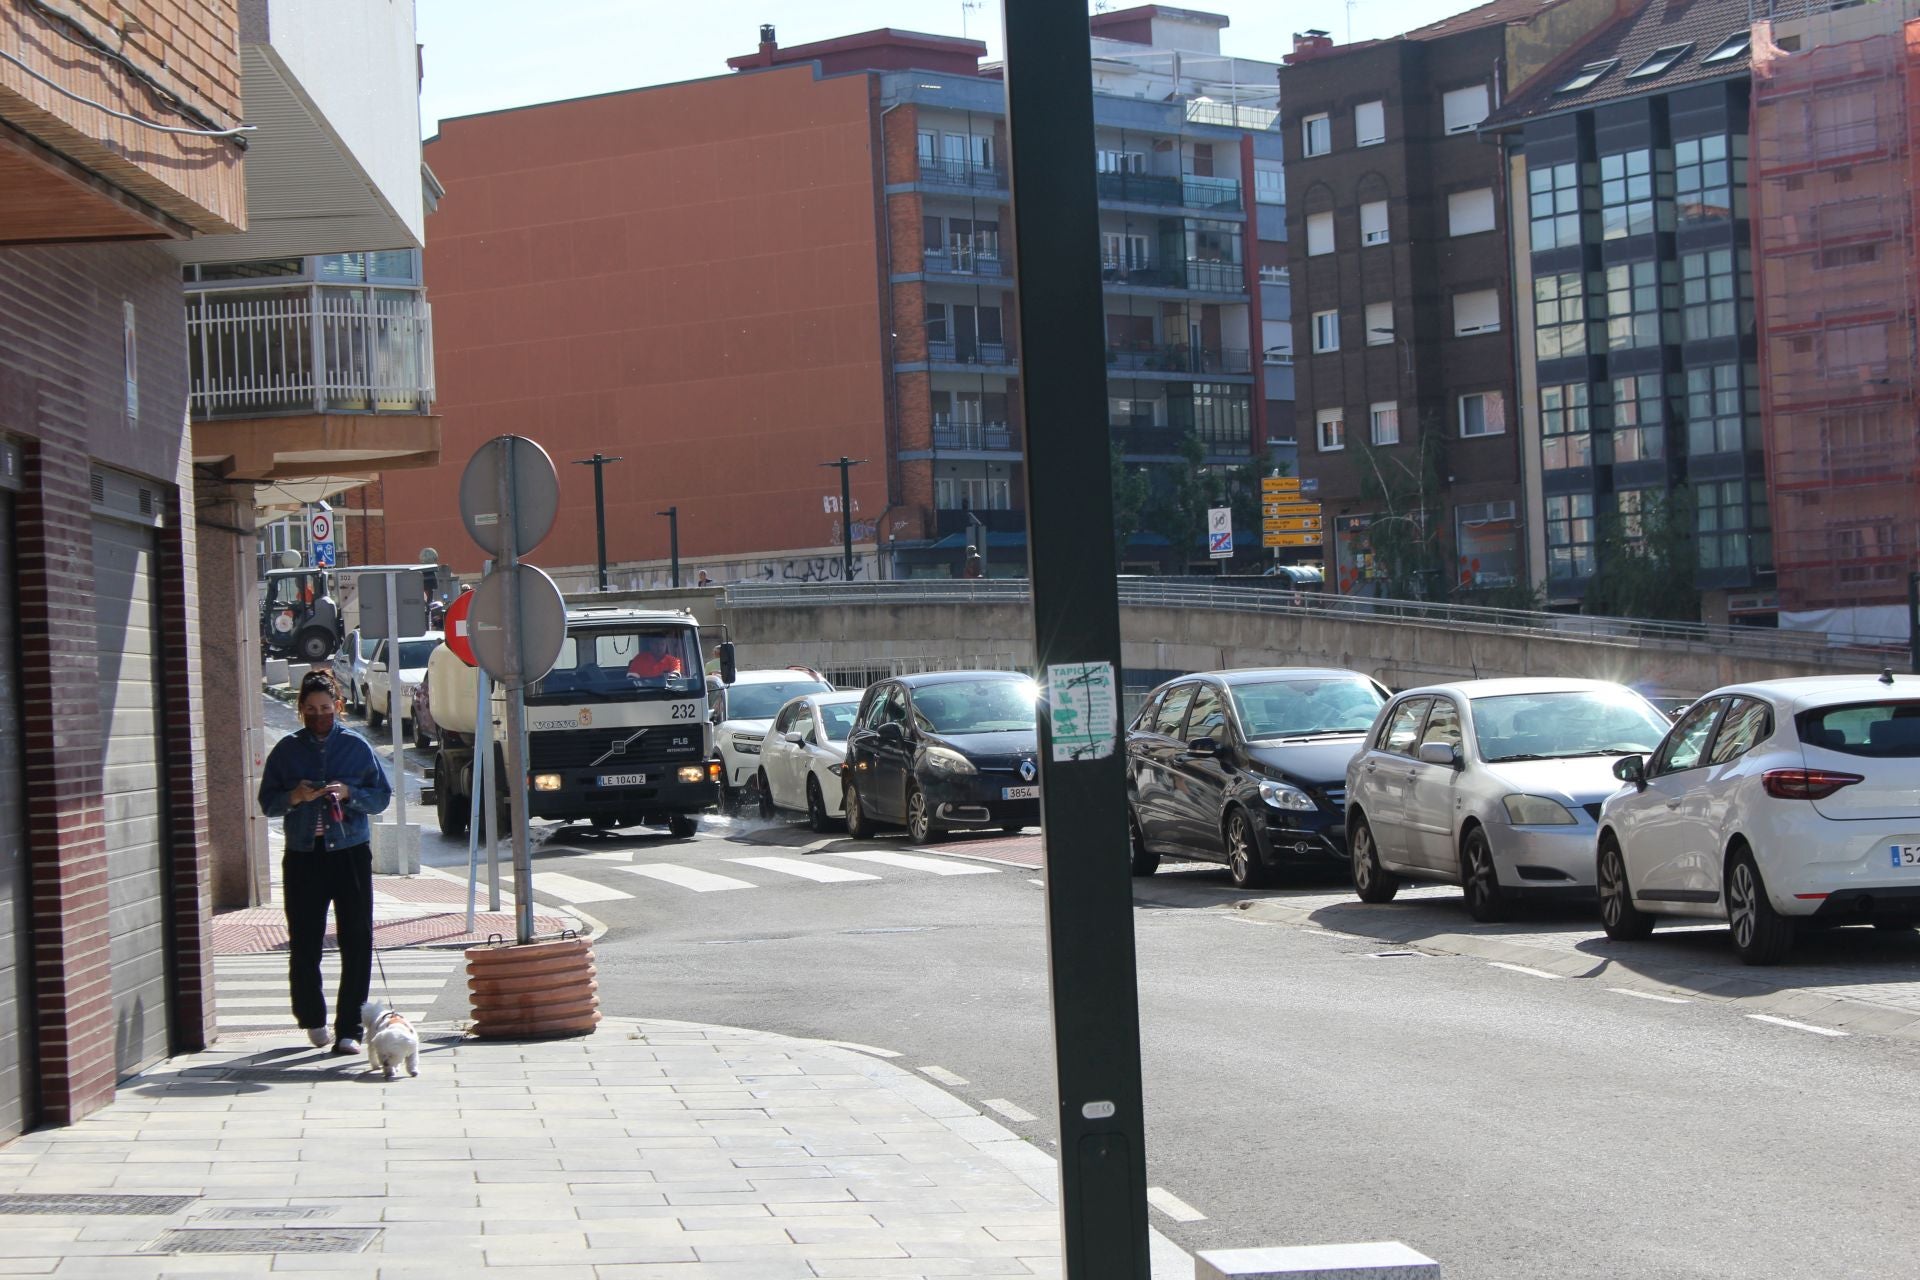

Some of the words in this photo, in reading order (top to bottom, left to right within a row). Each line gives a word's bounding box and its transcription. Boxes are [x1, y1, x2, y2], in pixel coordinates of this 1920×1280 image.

[316, 523, 325, 533] 10
[671, 703, 696, 719] 232
[534, 720, 579, 729] VOLVO
[602, 776, 613, 785] LE
[616, 776, 637, 785] 1040
[1010, 788, 1032, 798] 3854
